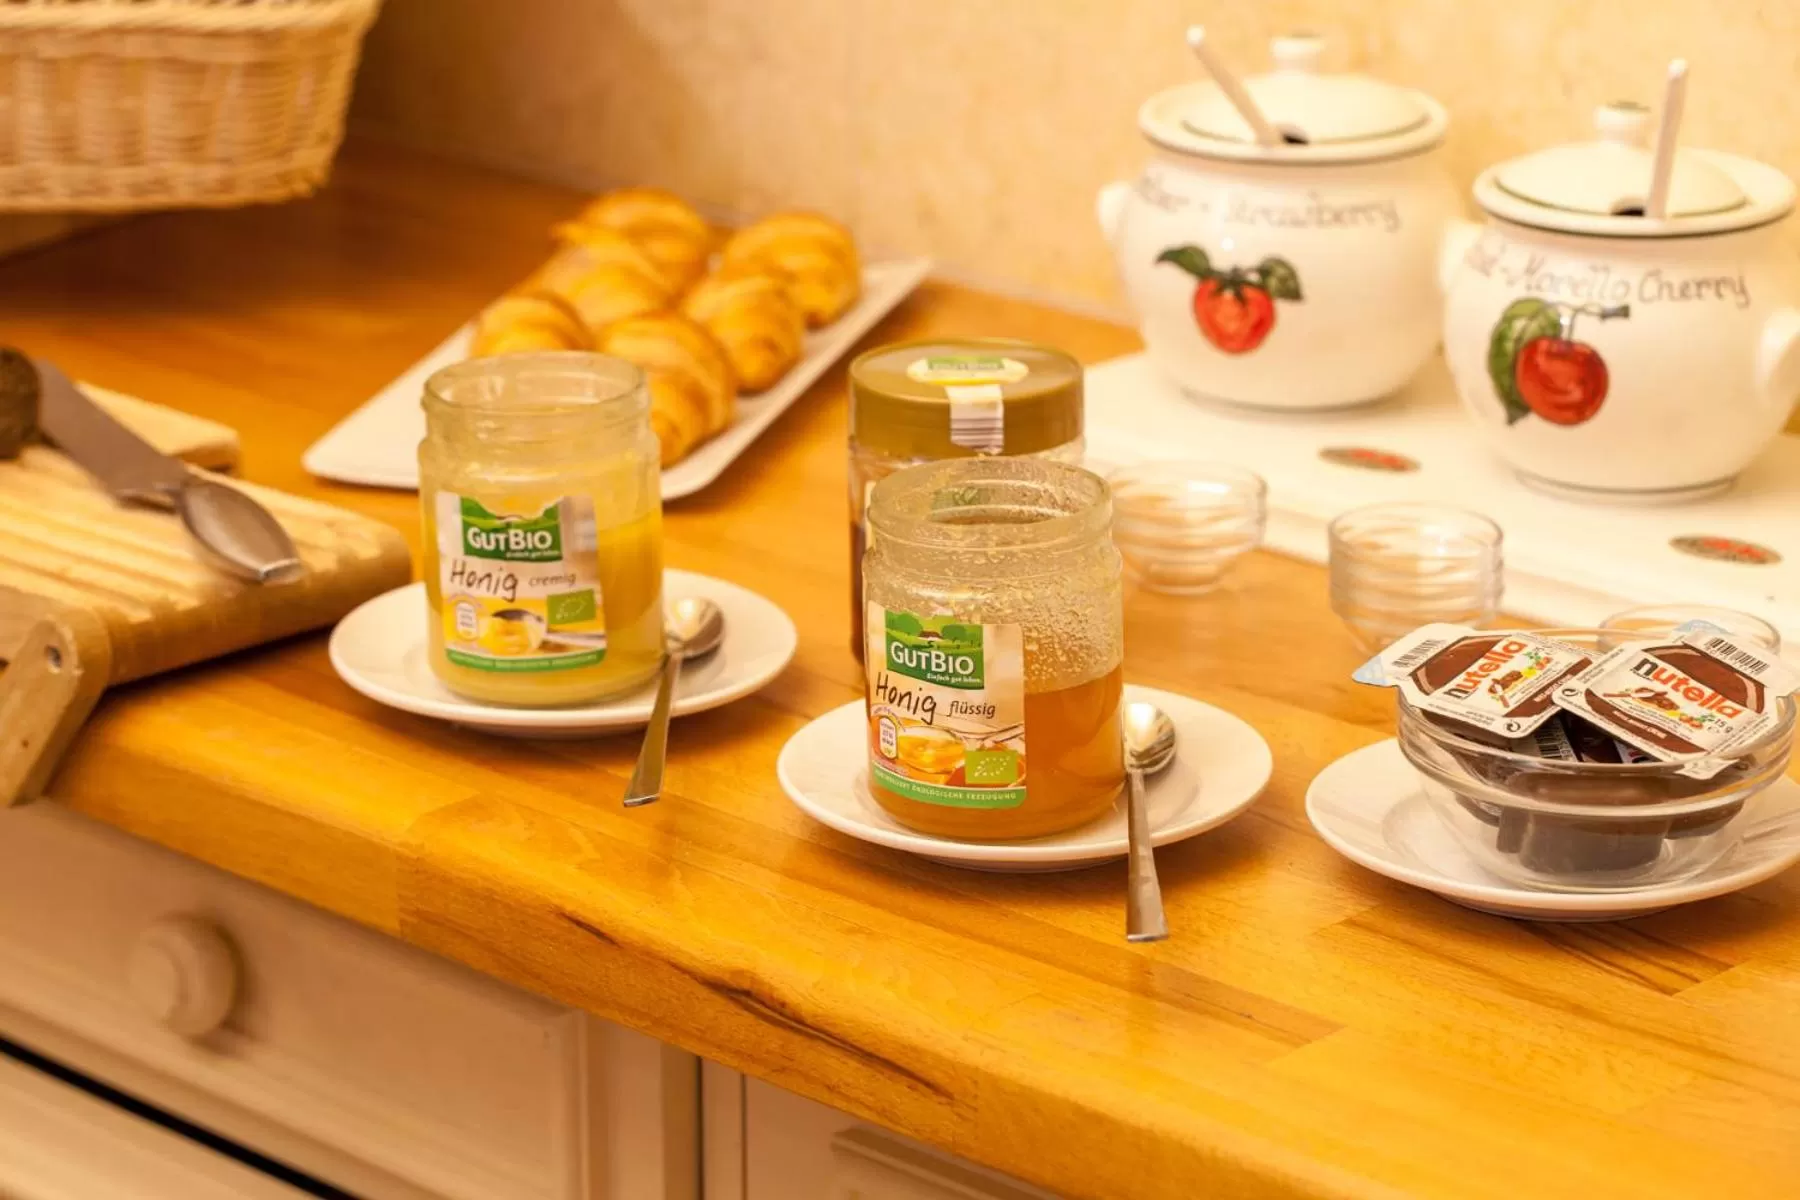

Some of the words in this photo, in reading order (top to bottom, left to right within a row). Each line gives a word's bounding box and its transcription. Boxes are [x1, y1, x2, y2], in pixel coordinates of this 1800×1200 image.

[1638, 262, 1750, 310] Cherry
[451, 560, 518, 603] Honig
[528, 573, 577, 587] cremig
[1443, 640, 1528, 700] nutella
[1633, 658, 1744, 719] nutella
[876, 672, 936, 725] Honig
[948, 700, 996, 718] flüssig
